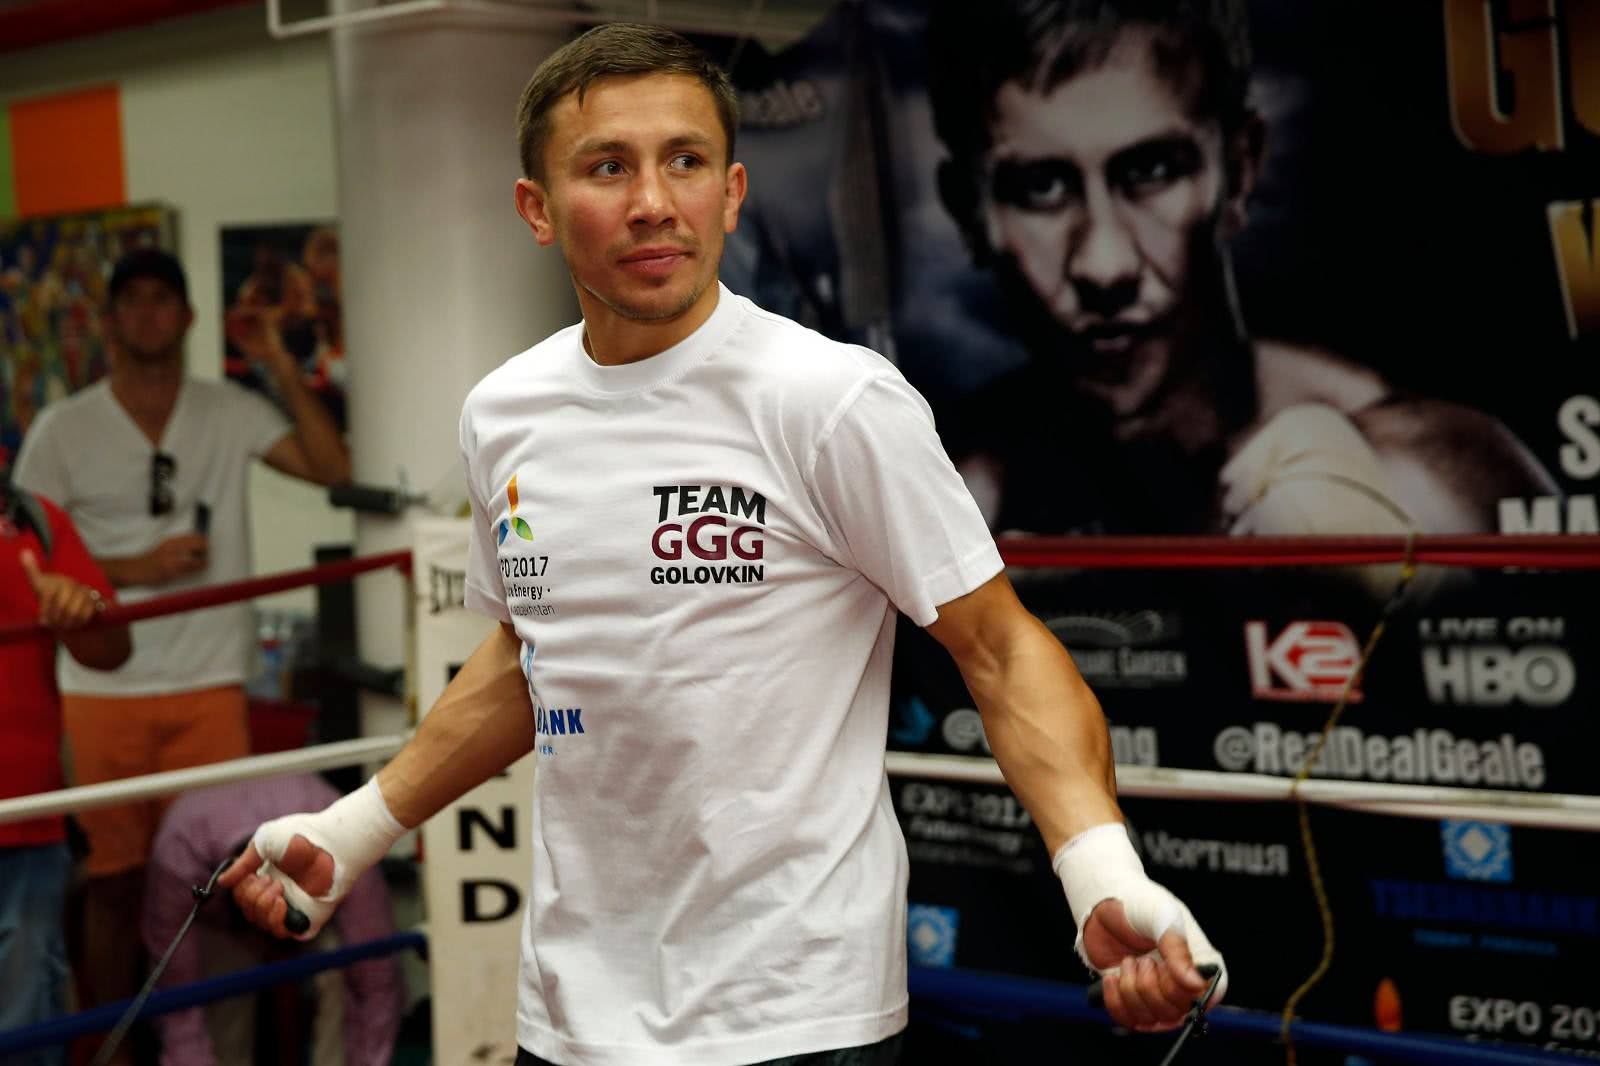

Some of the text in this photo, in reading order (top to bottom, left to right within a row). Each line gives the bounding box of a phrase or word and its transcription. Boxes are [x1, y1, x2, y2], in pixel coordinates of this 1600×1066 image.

[652, 484, 767, 525] TEAM
[650, 515, 764, 561] GGG
[515, 556, 549, 578] 2017
[649, 565, 765, 585] GOLOVKIN
[1418, 616, 1566, 641] LIVE ON
[1422, 646, 1577, 706] HBO
[536, 706, 586, 735] BANK
[1213, 721, 1547, 788] @RealDealGeale
[1449, 995, 1541, 1035] EXPO
